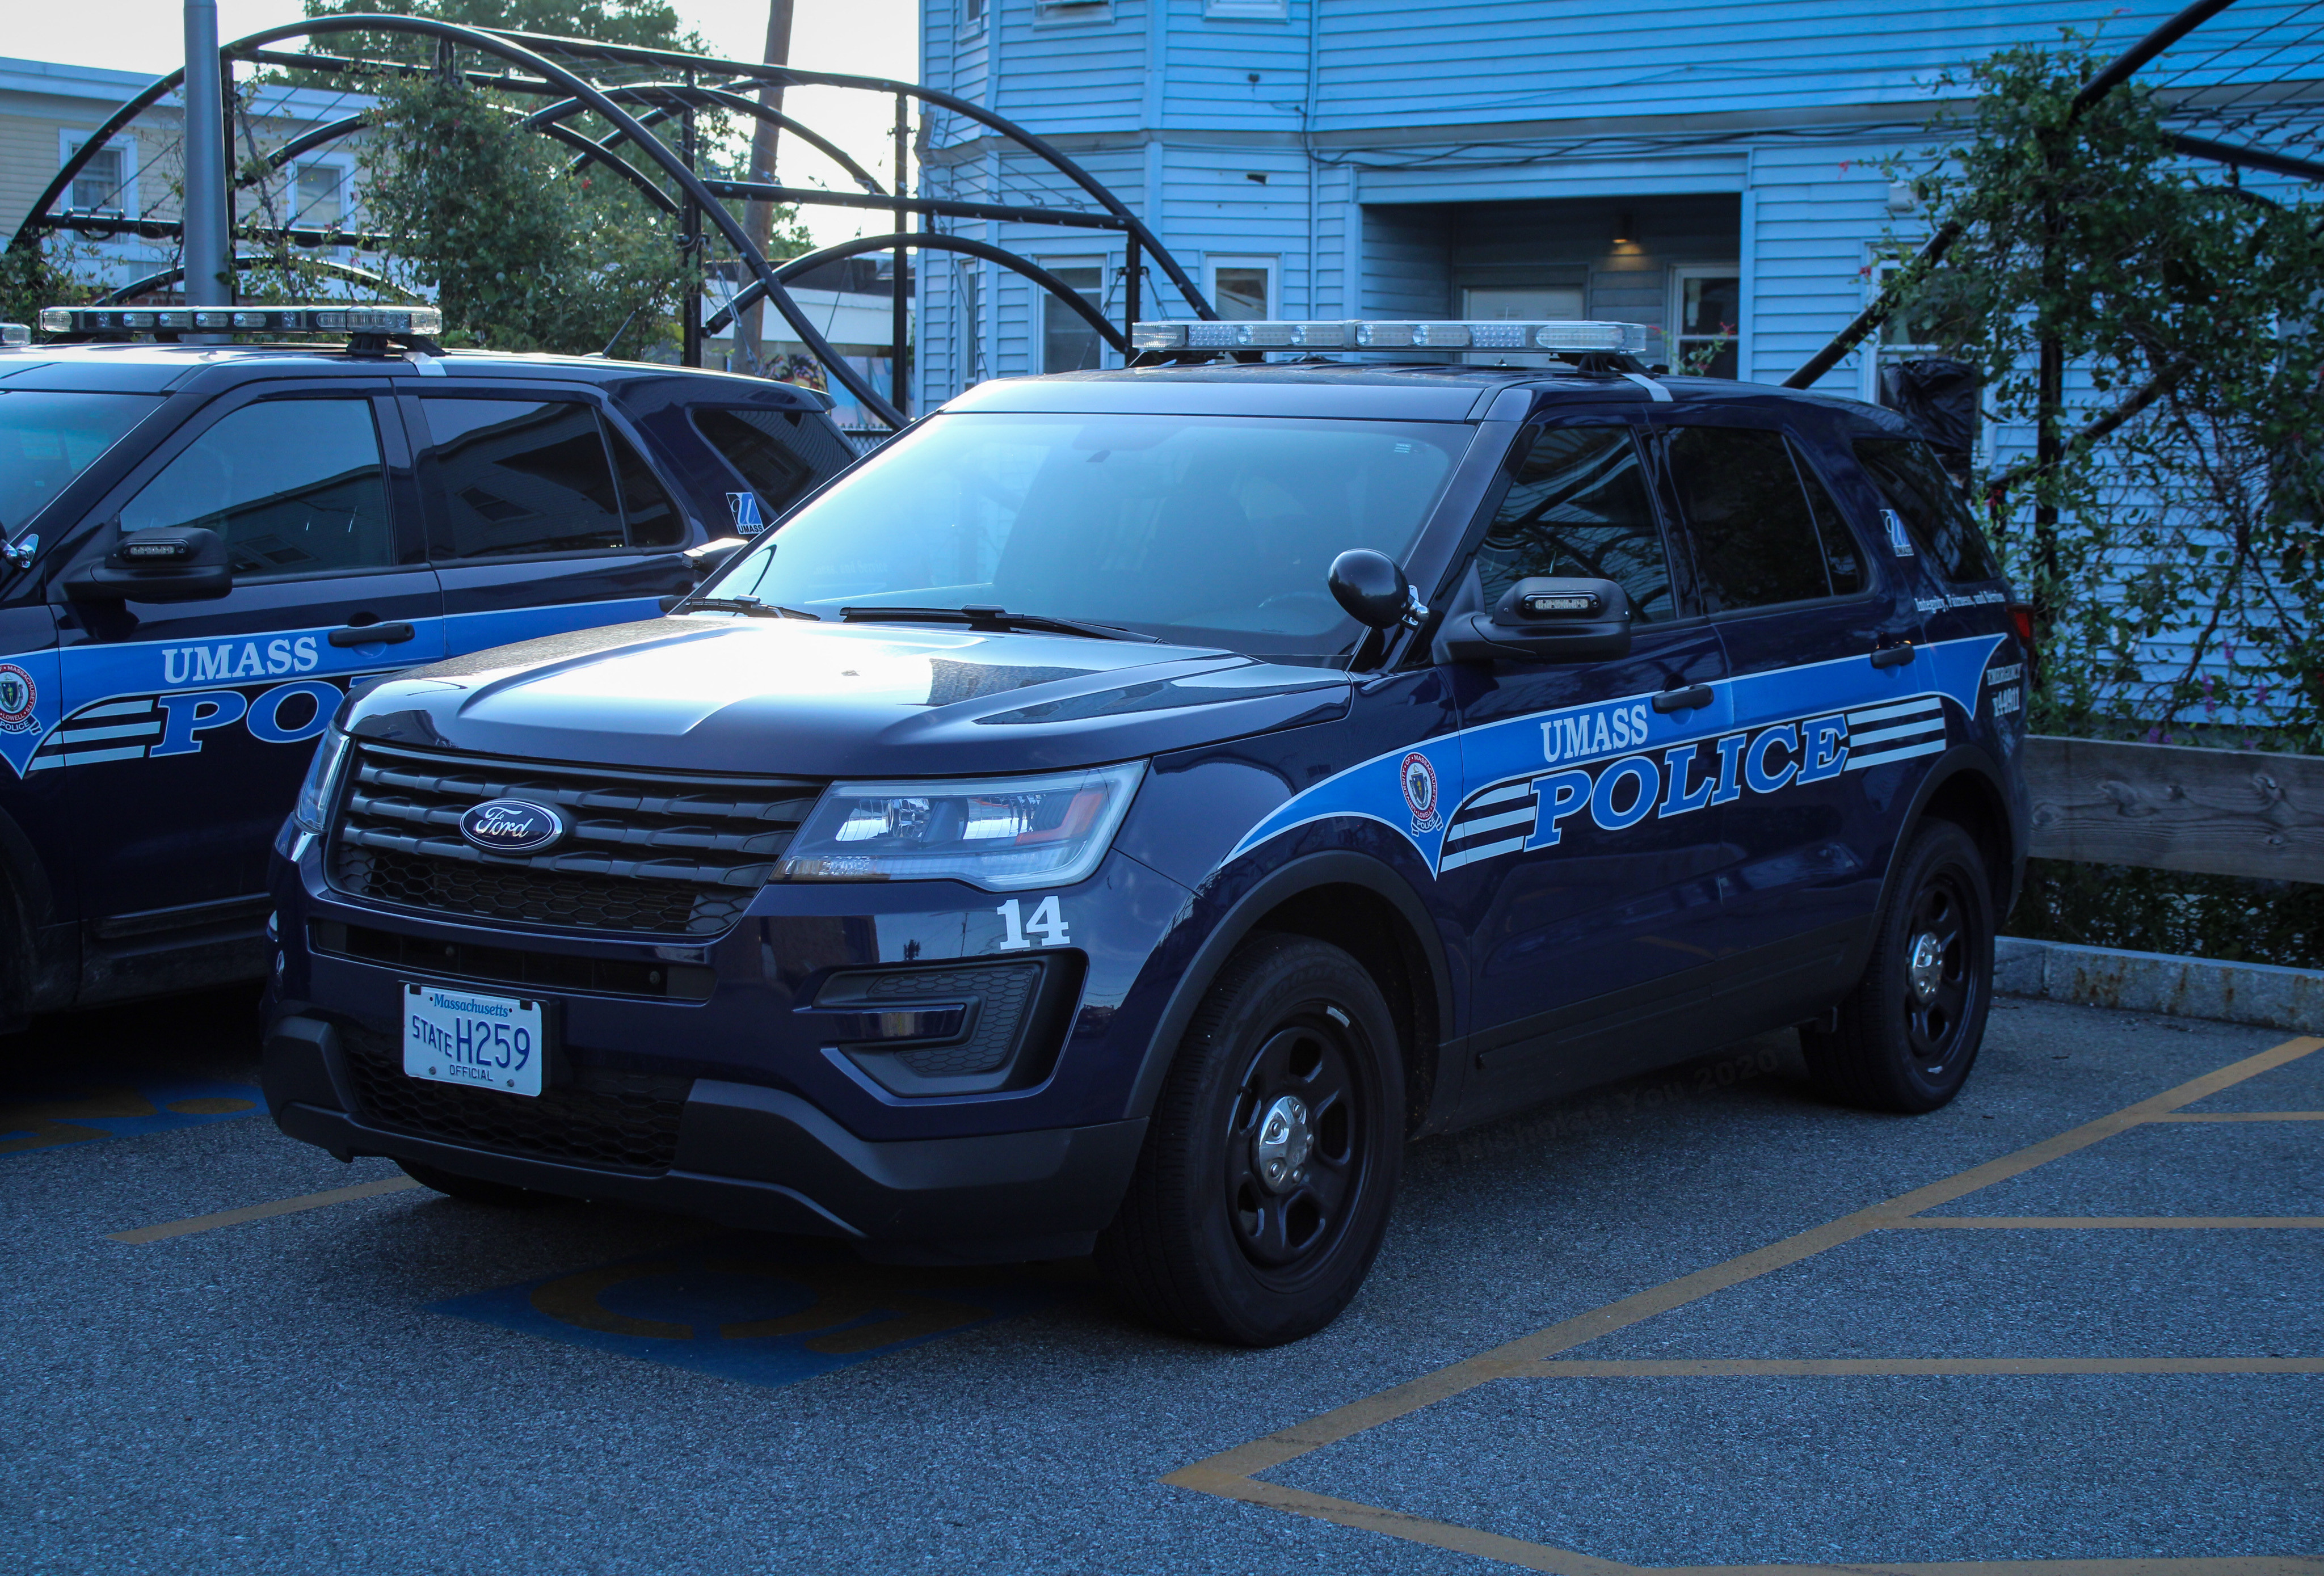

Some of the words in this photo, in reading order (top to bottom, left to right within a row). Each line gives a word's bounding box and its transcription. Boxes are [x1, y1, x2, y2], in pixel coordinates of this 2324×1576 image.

[738, 525, 763, 533] UMASS
[162, 637, 319, 683] UMASS
[7, 665, 35, 713] MASSACHUSETTS
[0, 719, 30, 731] POLICE
[1540, 705, 1648, 762] UMASS
[1401, 768, 1416, 814] UNIVERSITY
[1413, 755, 1437, 808] MASSACHUSETTS
[1523, 713, 1850, 853] POLICE
[475, 807, 534, 838] Ford
[1417, 810, 1432, 819] LOWELL
[1417, 818, 1436, 829] POLICE
[996, 895, 1071, 950] 14
[434, 993, 508, 1017] Massachusetts
[412, 1015, 453, 1058] STATE
[456, 1017, 531, 1071] H259
[449, 1064, 494, 1082] OFFICIAL
